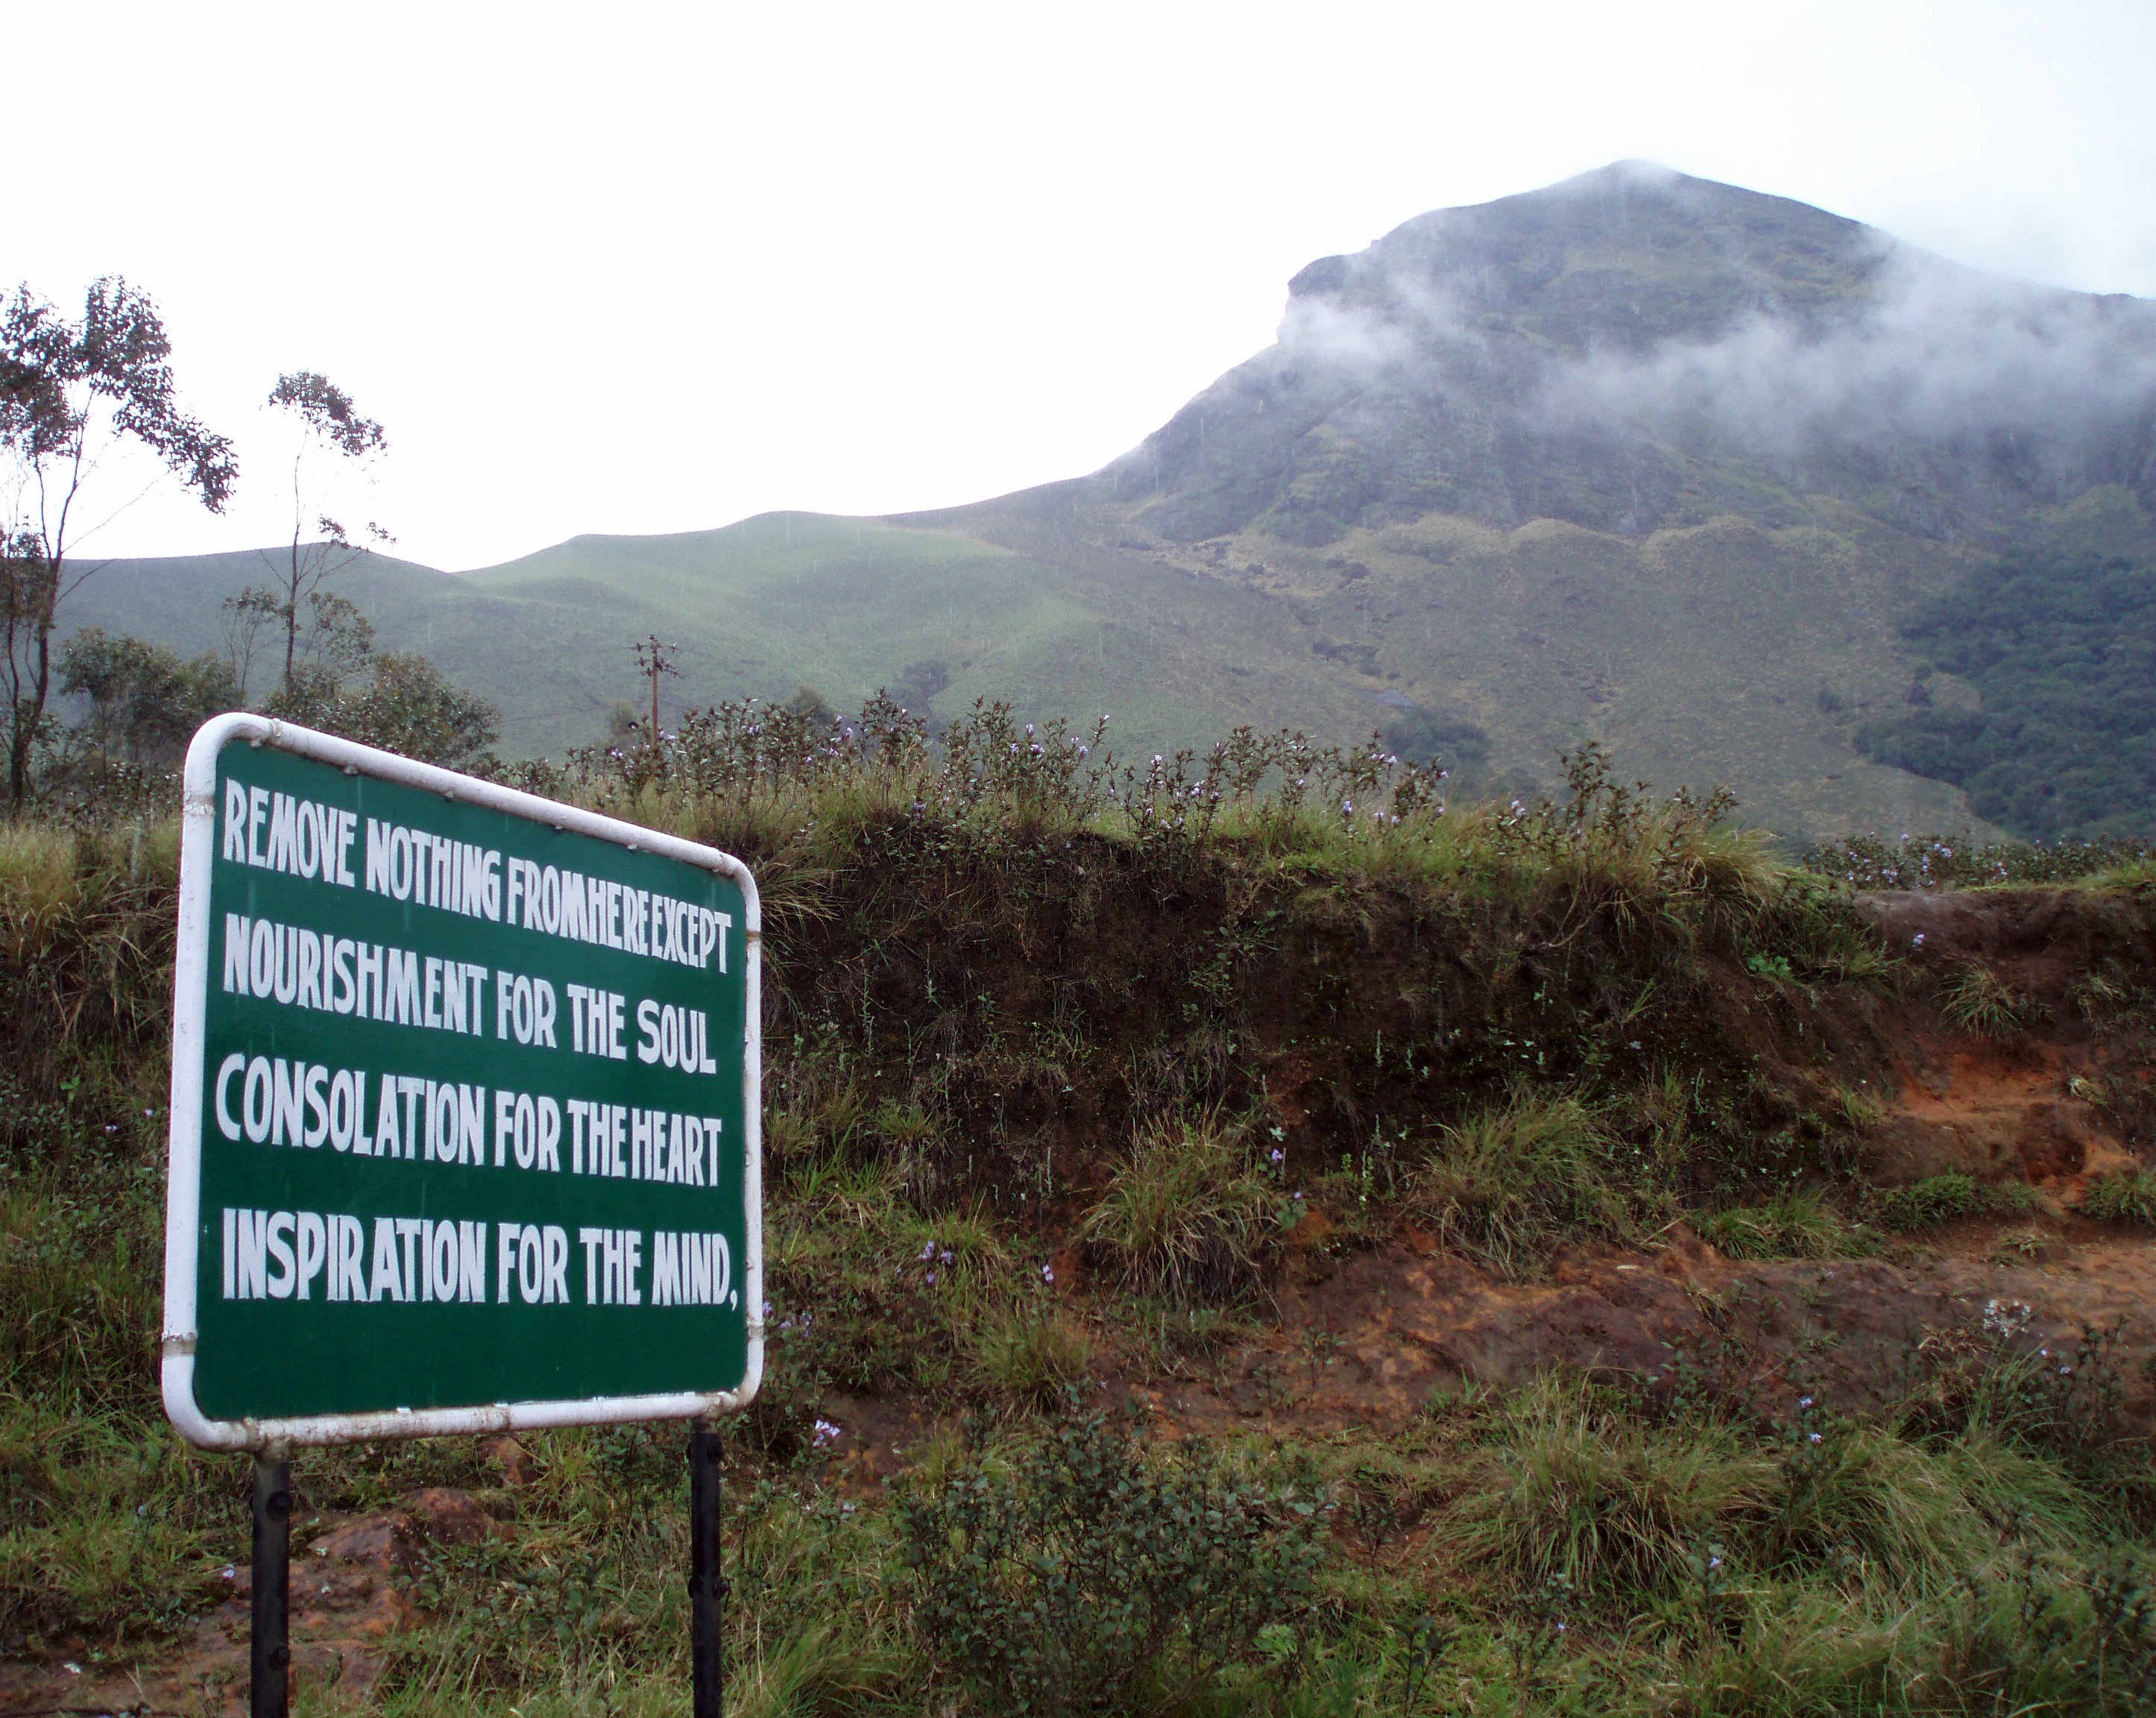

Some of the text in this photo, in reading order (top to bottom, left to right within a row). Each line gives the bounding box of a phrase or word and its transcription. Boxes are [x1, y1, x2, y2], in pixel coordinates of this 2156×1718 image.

[222, 777, 358, 888] REMOVE
[365, 817, 501, 922] NOTHING
[651, 893, 732, 974] EXCEPT
[223, 912, 716, 1074] NOURISHMENT FOR THE SOUL
[215, 1053, 722, 1187] CONSOLATION FOR THE HEART
[223, 1208, 487, 1303] INSPIRATION
[497, 1222, 570, 1304] FOR
[579, 1227, 641, 1306] THE
